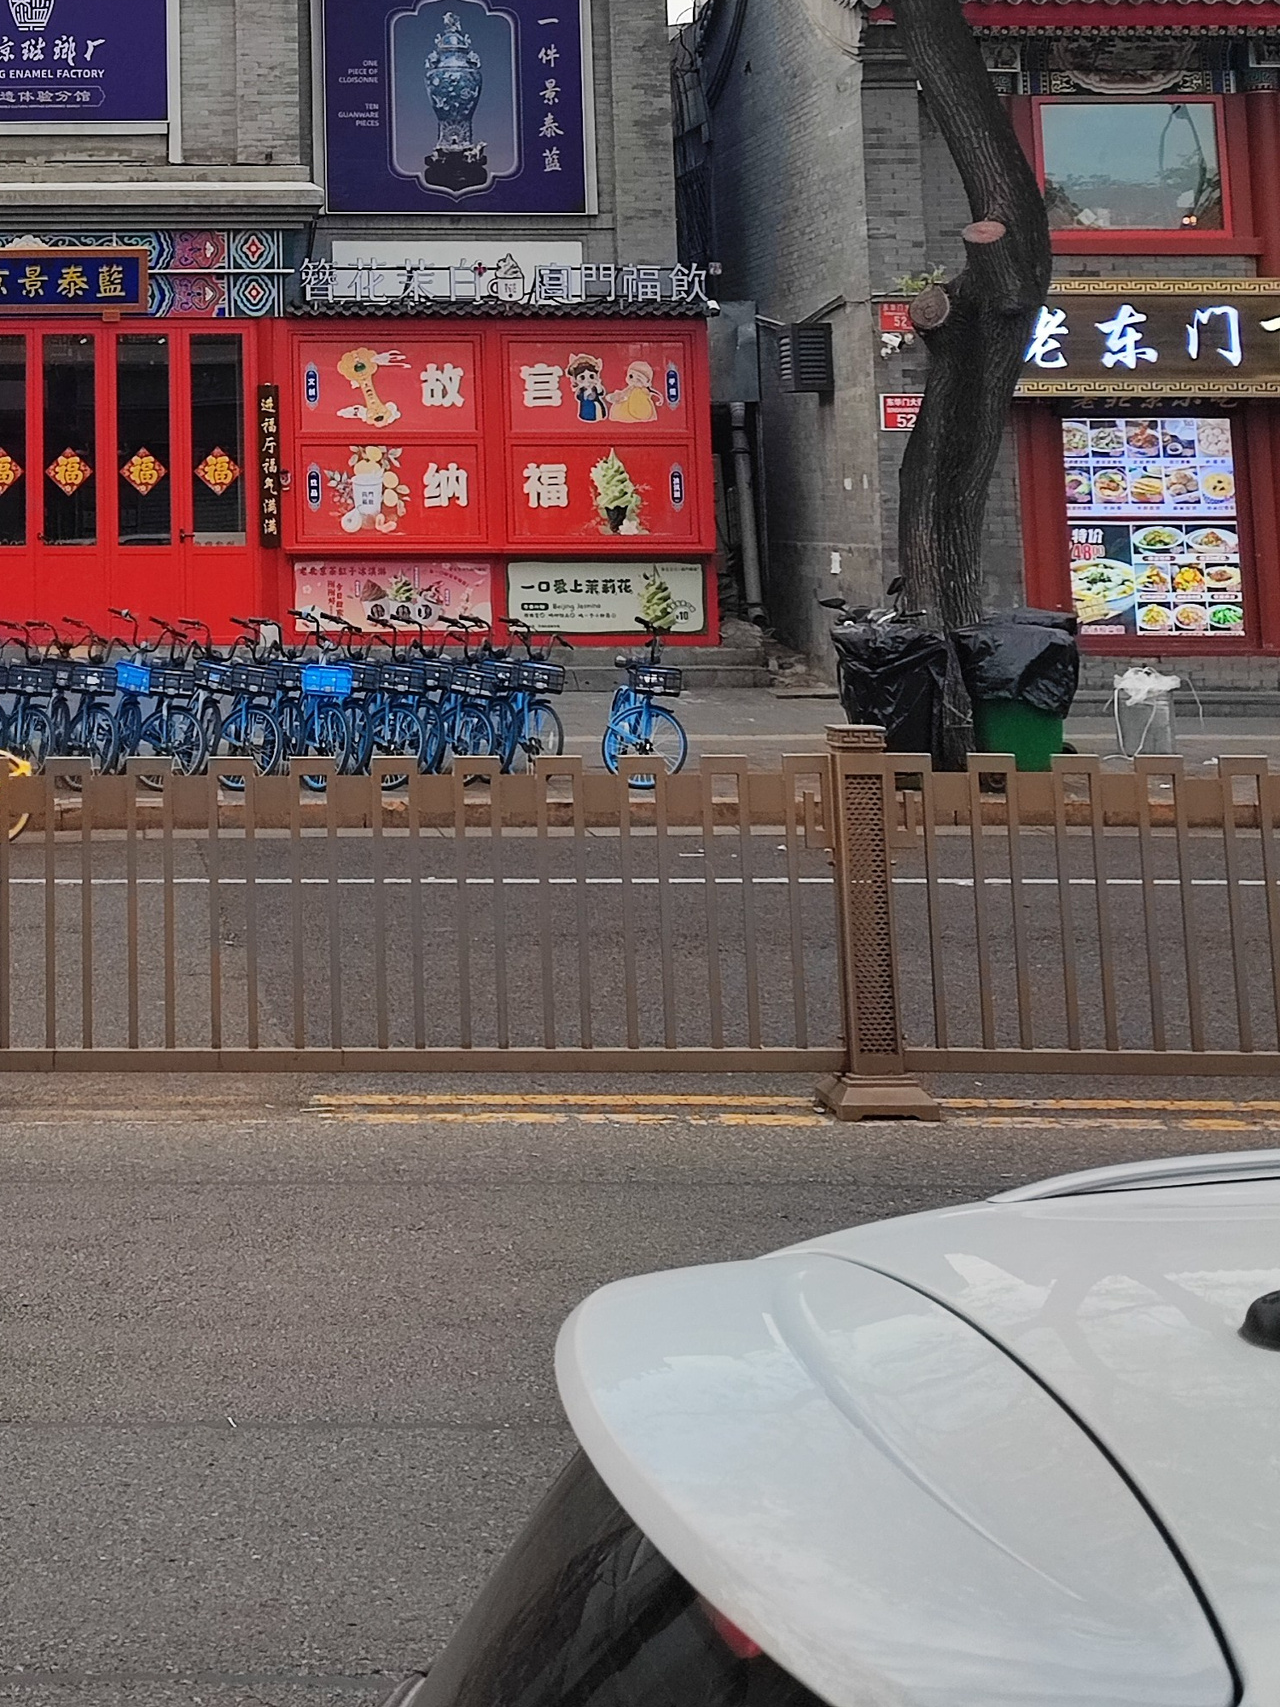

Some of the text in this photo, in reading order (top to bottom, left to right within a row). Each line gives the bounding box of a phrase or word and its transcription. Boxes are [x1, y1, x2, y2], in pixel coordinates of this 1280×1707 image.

[9, 69, 54, 79] ENAMEL
[56, 69, 105, 79] FACTORY
[537, 18, 564, 172] 一件景泰蓝
[894, 316, 908, 327] 52
[1025, 302, 1280, 369] 老东门
[420, 363, 563, 408] 故 宫
[896, 413, 917, 428] 52
[57, 455, 84, 484] 福
[131, 455, 159, 484] 福
[205, 455, 233, 484] 福
[261, 396, 277, 535] 进福厅福气满满
[422, 462, 569, 509] 纳 福
